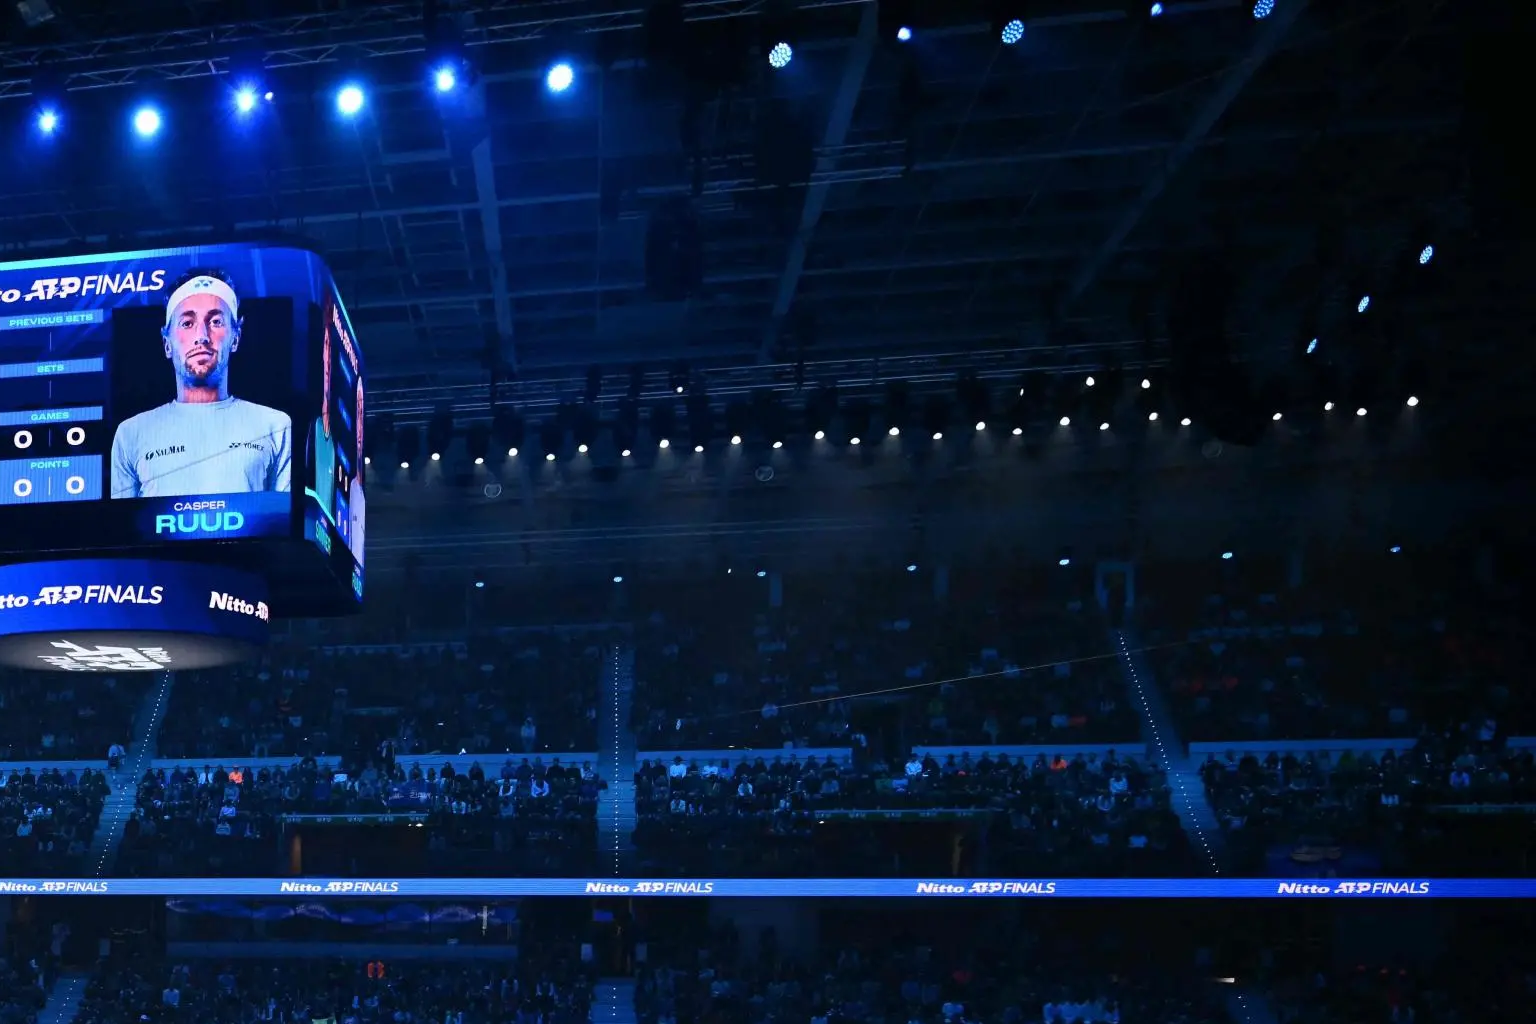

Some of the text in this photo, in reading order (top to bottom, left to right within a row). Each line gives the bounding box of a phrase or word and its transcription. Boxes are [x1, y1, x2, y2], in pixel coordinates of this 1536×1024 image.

[23, 277, 80, 301] ATP
[82, 270, 165, 296] FINALS
[9, 313, 94, 327] PREVIOUS SETS
[37, 363, 64, 374] SETS
[31, 411, 69, 422] GAMES
[14, 427, 85, 448] 0 0
[30, 460, 70, 470] POINTS
[13, 475, 85, 498] 0 0
[174, 501, 225, 511] CASPER
[155, 511, 243, 534] RUUD
[30, 586, 82, 605] ATP
[85, 585, 163, 604] FINALS
[209, 591, 254, 614] Nitto
[0, 882, 107, 891] Nitto ATP FINALS
[281, 882, 398, 891] Nitto ATP FINALS
[586, 883, 712, 892] Nitto ATP FINALS
[917, 883, 1055, 893] Nitto ATP FINALS
[1278, 883, 1429, 893] Nitto ATP FINALS
